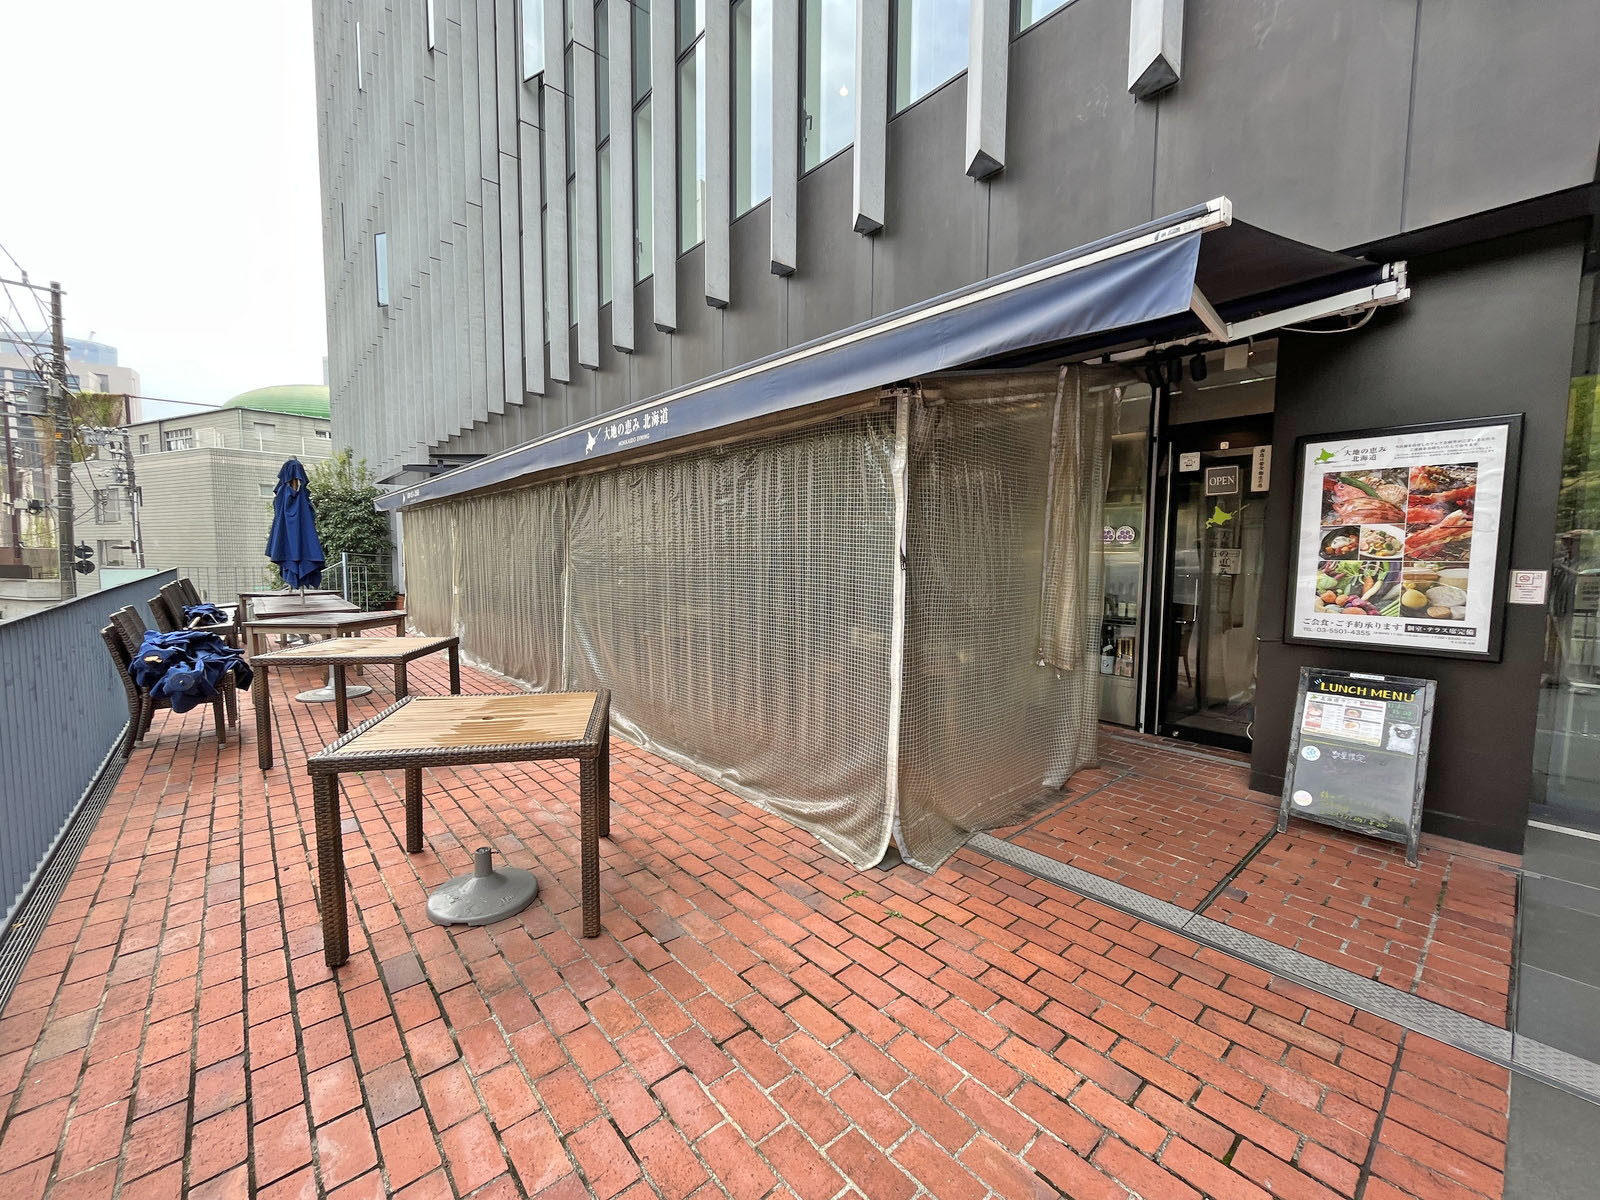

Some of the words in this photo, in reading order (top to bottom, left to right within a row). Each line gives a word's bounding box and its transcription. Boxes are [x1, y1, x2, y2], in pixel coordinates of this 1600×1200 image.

[604, 418, 640, 441] 大地の恵み
[643, 407, 669, 430] 北海道
[1344, 446, 1386, 456] 大地の恵み
[1351, 454, 1377, 462] 北海道
[1209, 475, 1235, 486] OPEN
[1316, 627, 1371, 636] 03-5501-4355
[1320, 682, 1367, 696] LUNCH
[1370, 688, 1415, 703] MENU
